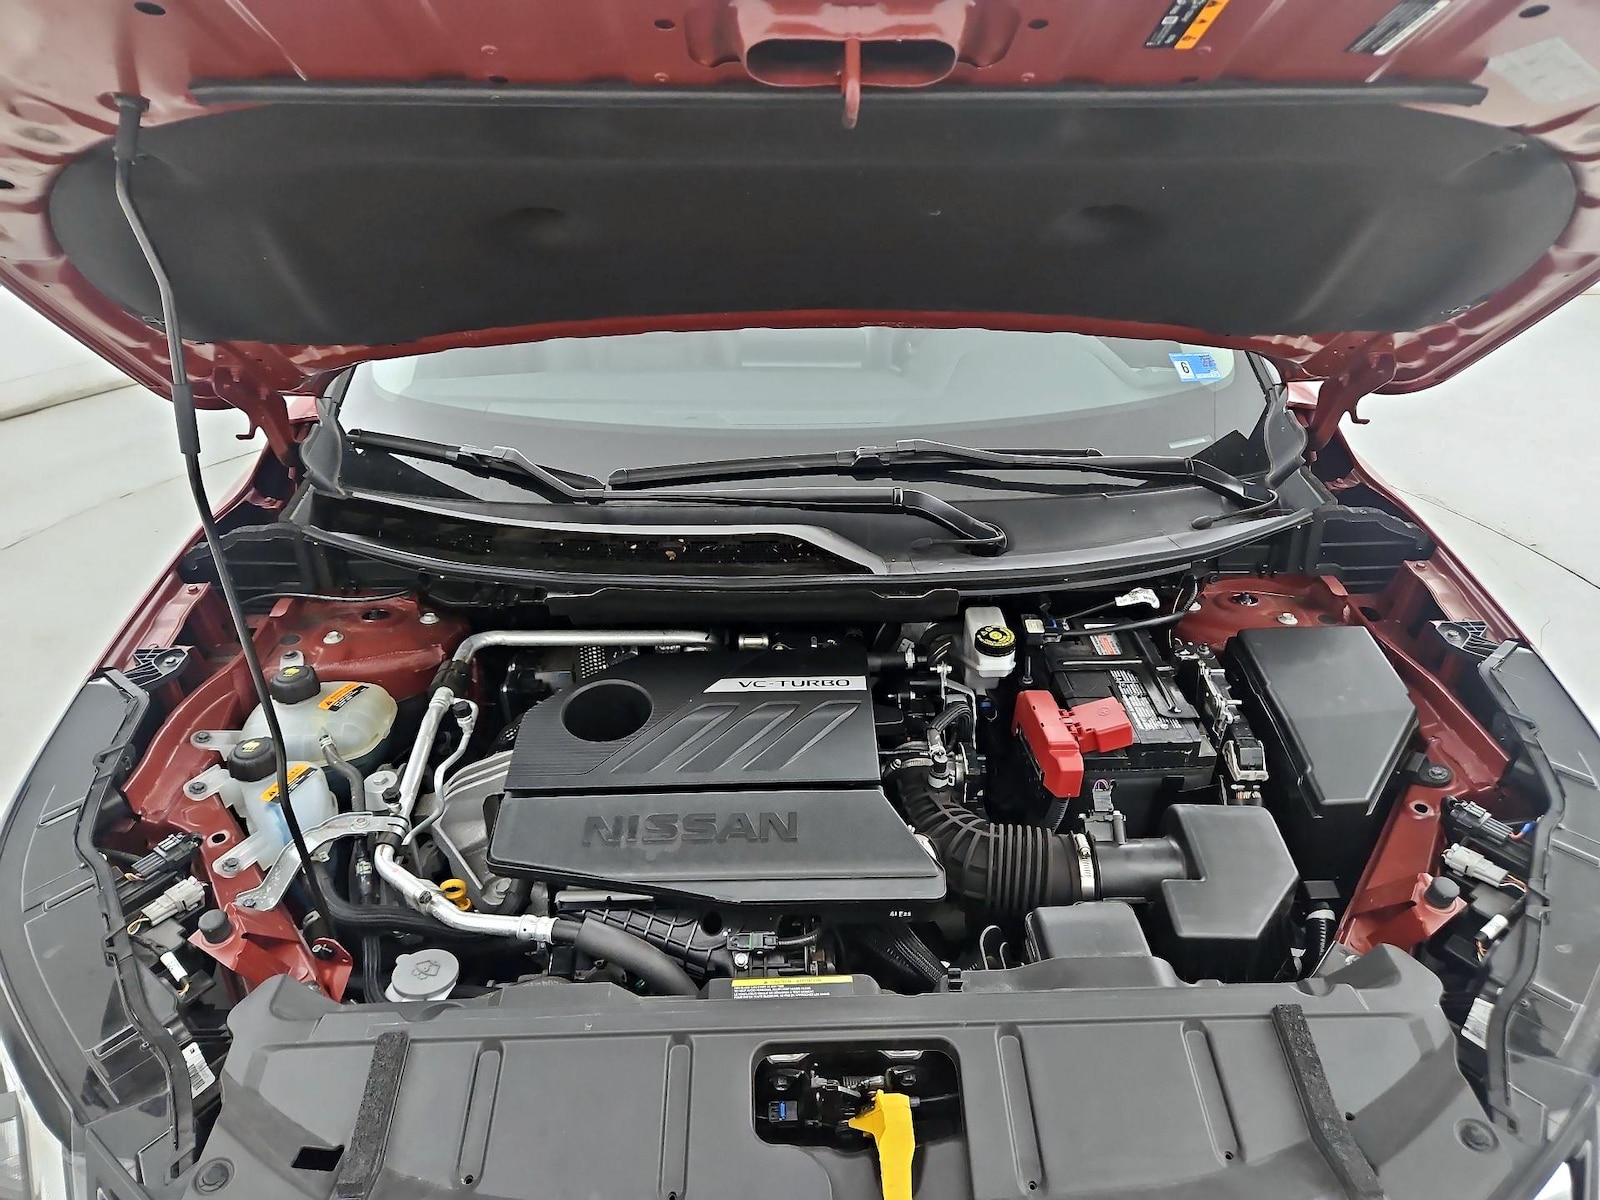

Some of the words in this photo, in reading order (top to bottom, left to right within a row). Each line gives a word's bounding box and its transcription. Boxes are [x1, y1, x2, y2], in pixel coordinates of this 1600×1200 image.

[1180, 361, 1190, 374] 6
[738, 679, 850, 688] VC-TURBO
[582, 811, 798, 847] NISSAN
